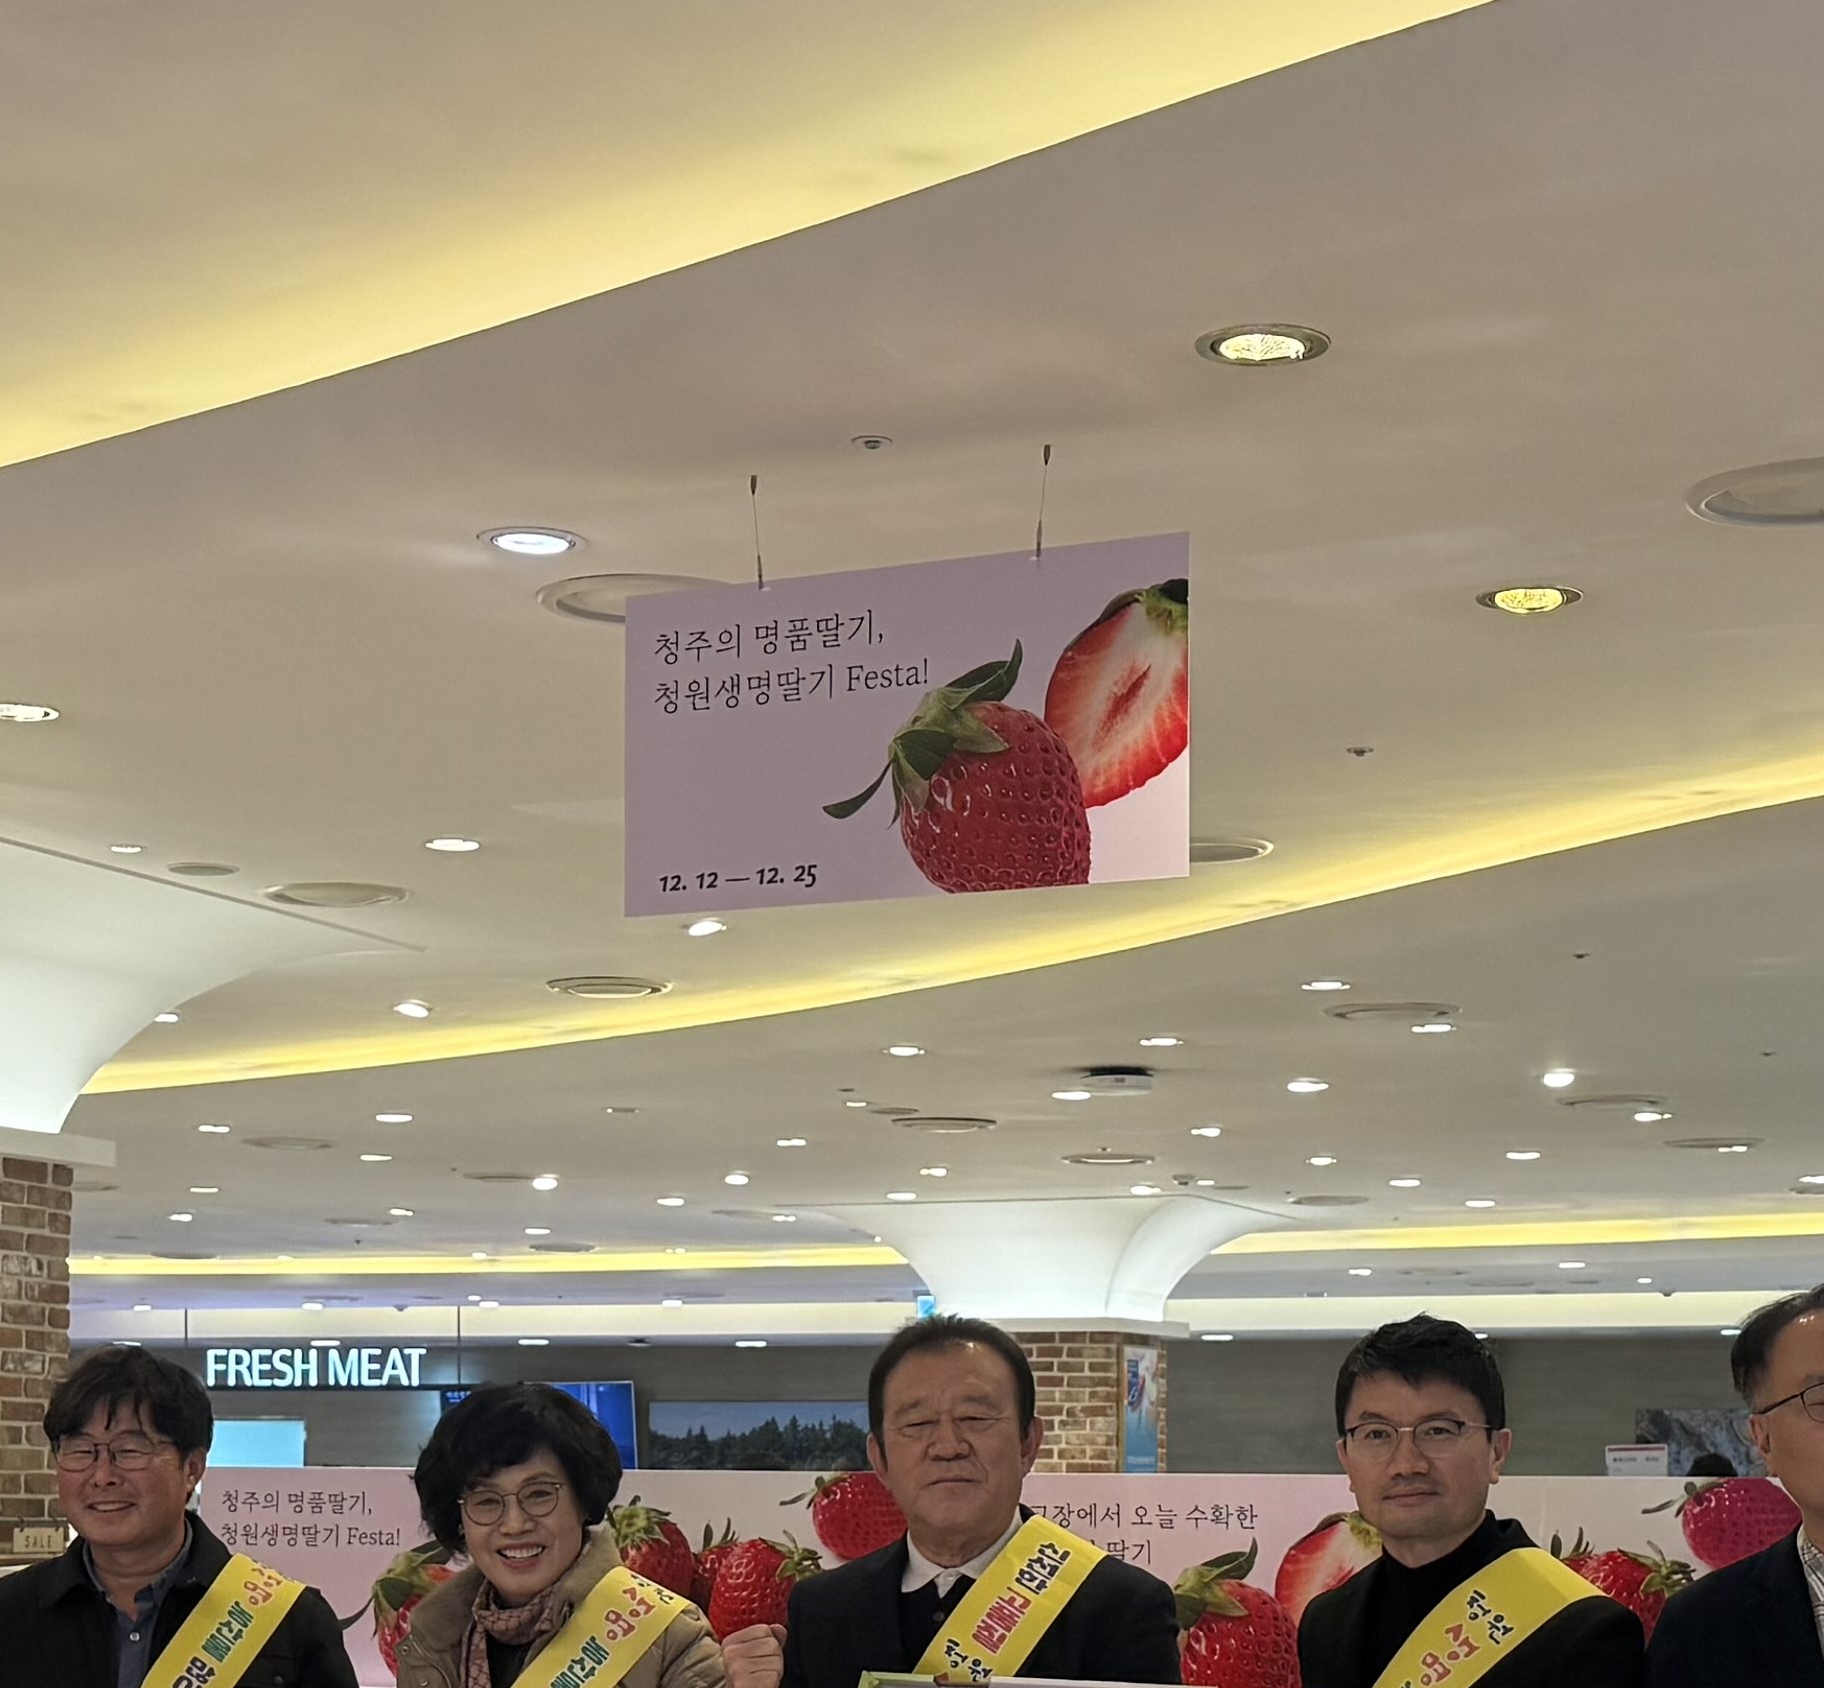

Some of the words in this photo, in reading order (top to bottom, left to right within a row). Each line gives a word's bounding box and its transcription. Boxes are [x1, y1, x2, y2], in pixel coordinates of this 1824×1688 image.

[653, 623, 743, 665] 청주의
[754, 608, 884, 657] 명품딸기,
[653, 668, 835, 715] 청원생명딸기
[846, 657, 930, 693] Festa!
[659, 872, 687, 894] 12.
[695, 870, 719, 891] 12
[756, 866, 785, 888] 12.
[793, 864, 818, 889] 25
[206, 1347, 318, 1387] FRESH
[328, 1347, 427, 1387] MEAT
[221, 1490, 280, 1515] 청주의
[287, 1490, 373, 1516] 명품딸기,
[1131, 1503, 1179, 1530] 오늘
[1185, 1504, 1259, 1530] 수확한
[24, 1534, 52, 1549] SALE
[221, 1522, 341, 1548] 청원생명딸기
[347, 1526, 402, 1547] Festa!
[1015, 1541, 1072, 1596] 신선한
[201, 1600, 255, 1664] 농산물
[604, 1586, 657, 1641] 생명
[1466, 1589, 1515, 1645] 청원
[944, 1638, 993, 1683] 청원
[1420, 1622, 1482, 1687] 생명
